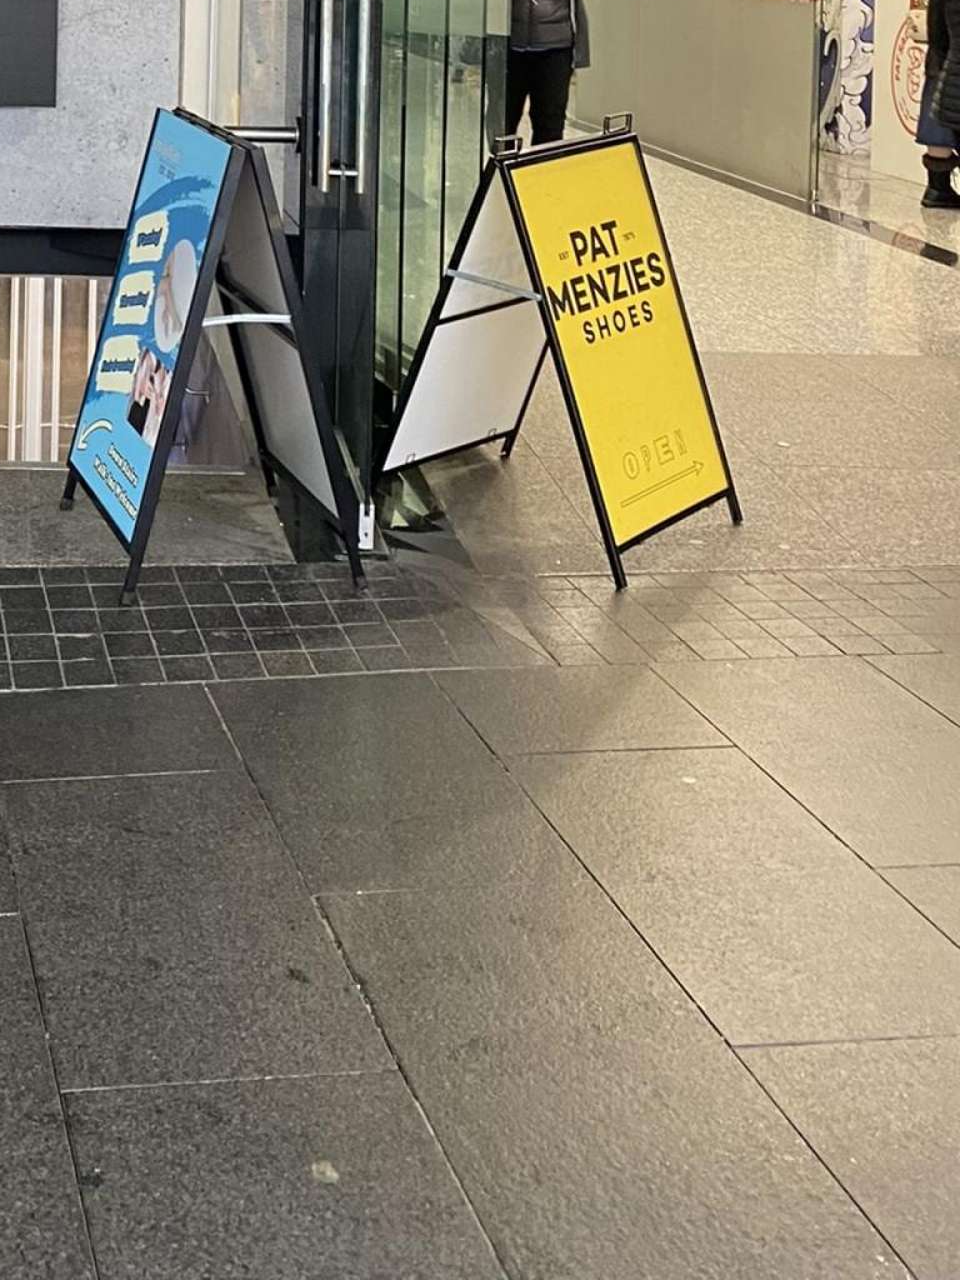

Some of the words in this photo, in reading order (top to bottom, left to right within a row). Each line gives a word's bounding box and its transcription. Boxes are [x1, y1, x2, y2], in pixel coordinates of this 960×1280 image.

[569, 220, 619, 267] PAT
[546, 252, 665, 322] MENZIES
[583, 300, 653, 344] SHOES
